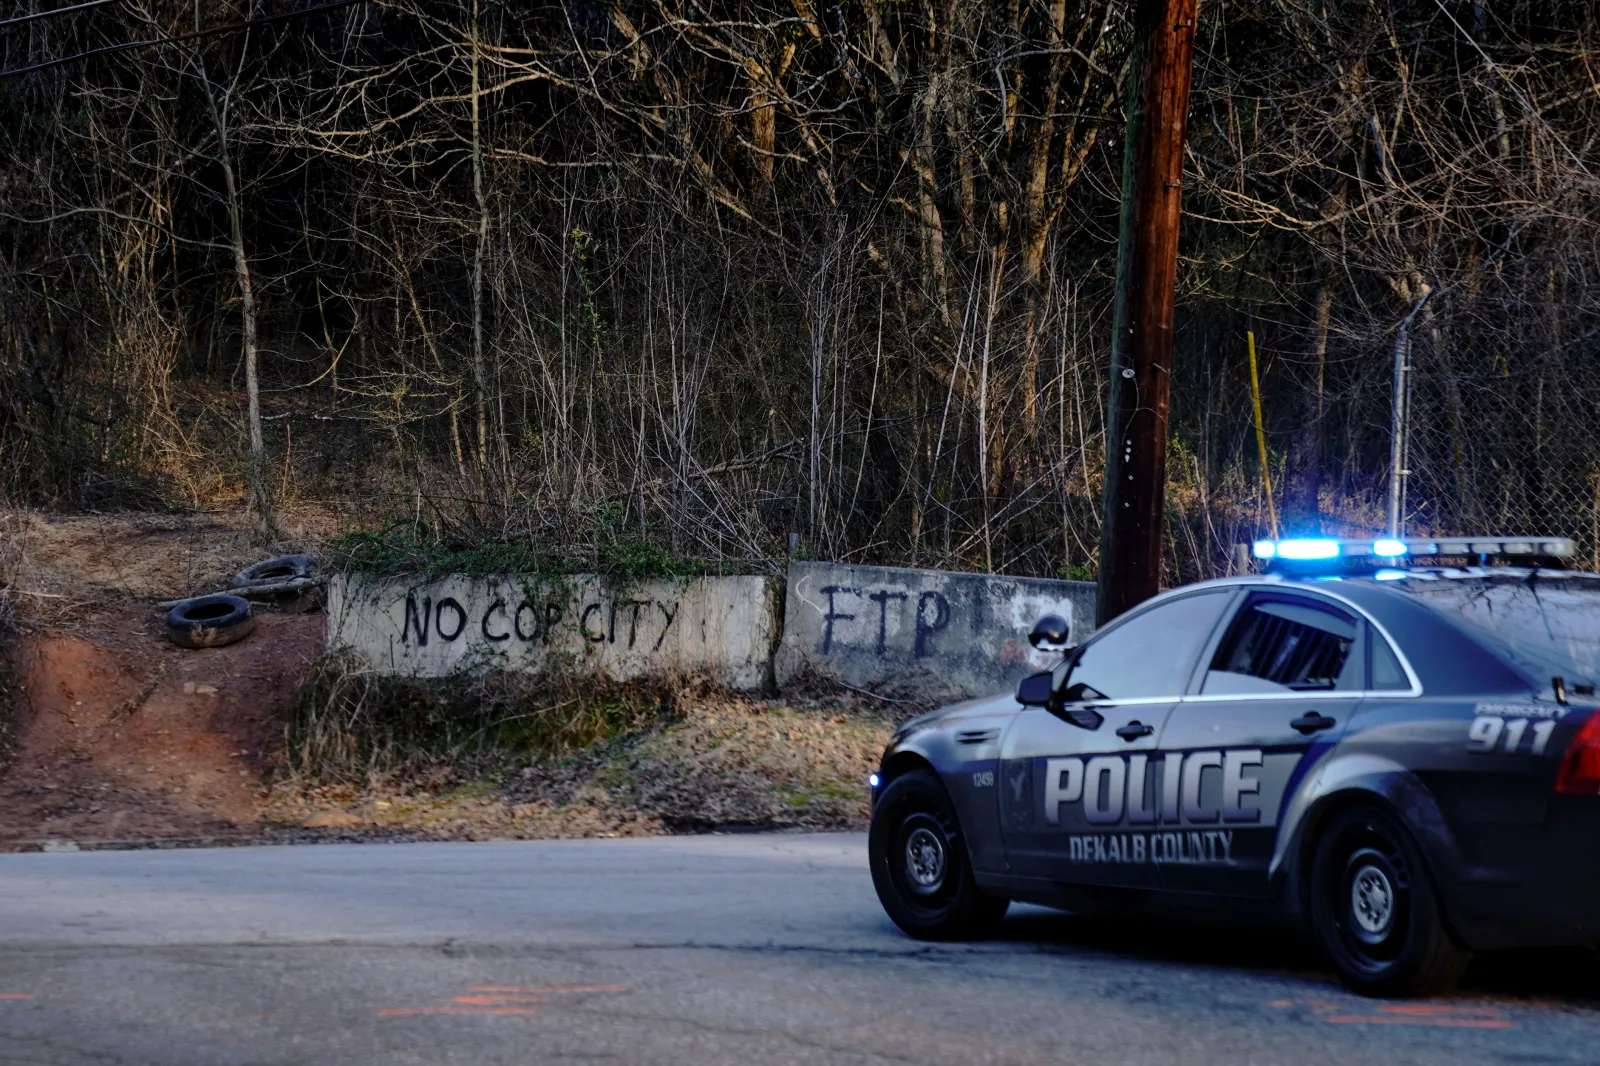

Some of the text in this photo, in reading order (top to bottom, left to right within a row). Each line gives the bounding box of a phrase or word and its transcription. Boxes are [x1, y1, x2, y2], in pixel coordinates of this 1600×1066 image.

[402, 590, 679, 651] NO COP CITY
[819, 585, 951, 658] FTP
[1466, 715, 1557, 755] 911
[1044, 749, 1263, 826] POLICE
[1068, 831, 1234, 865] DEKALB COUNTY
